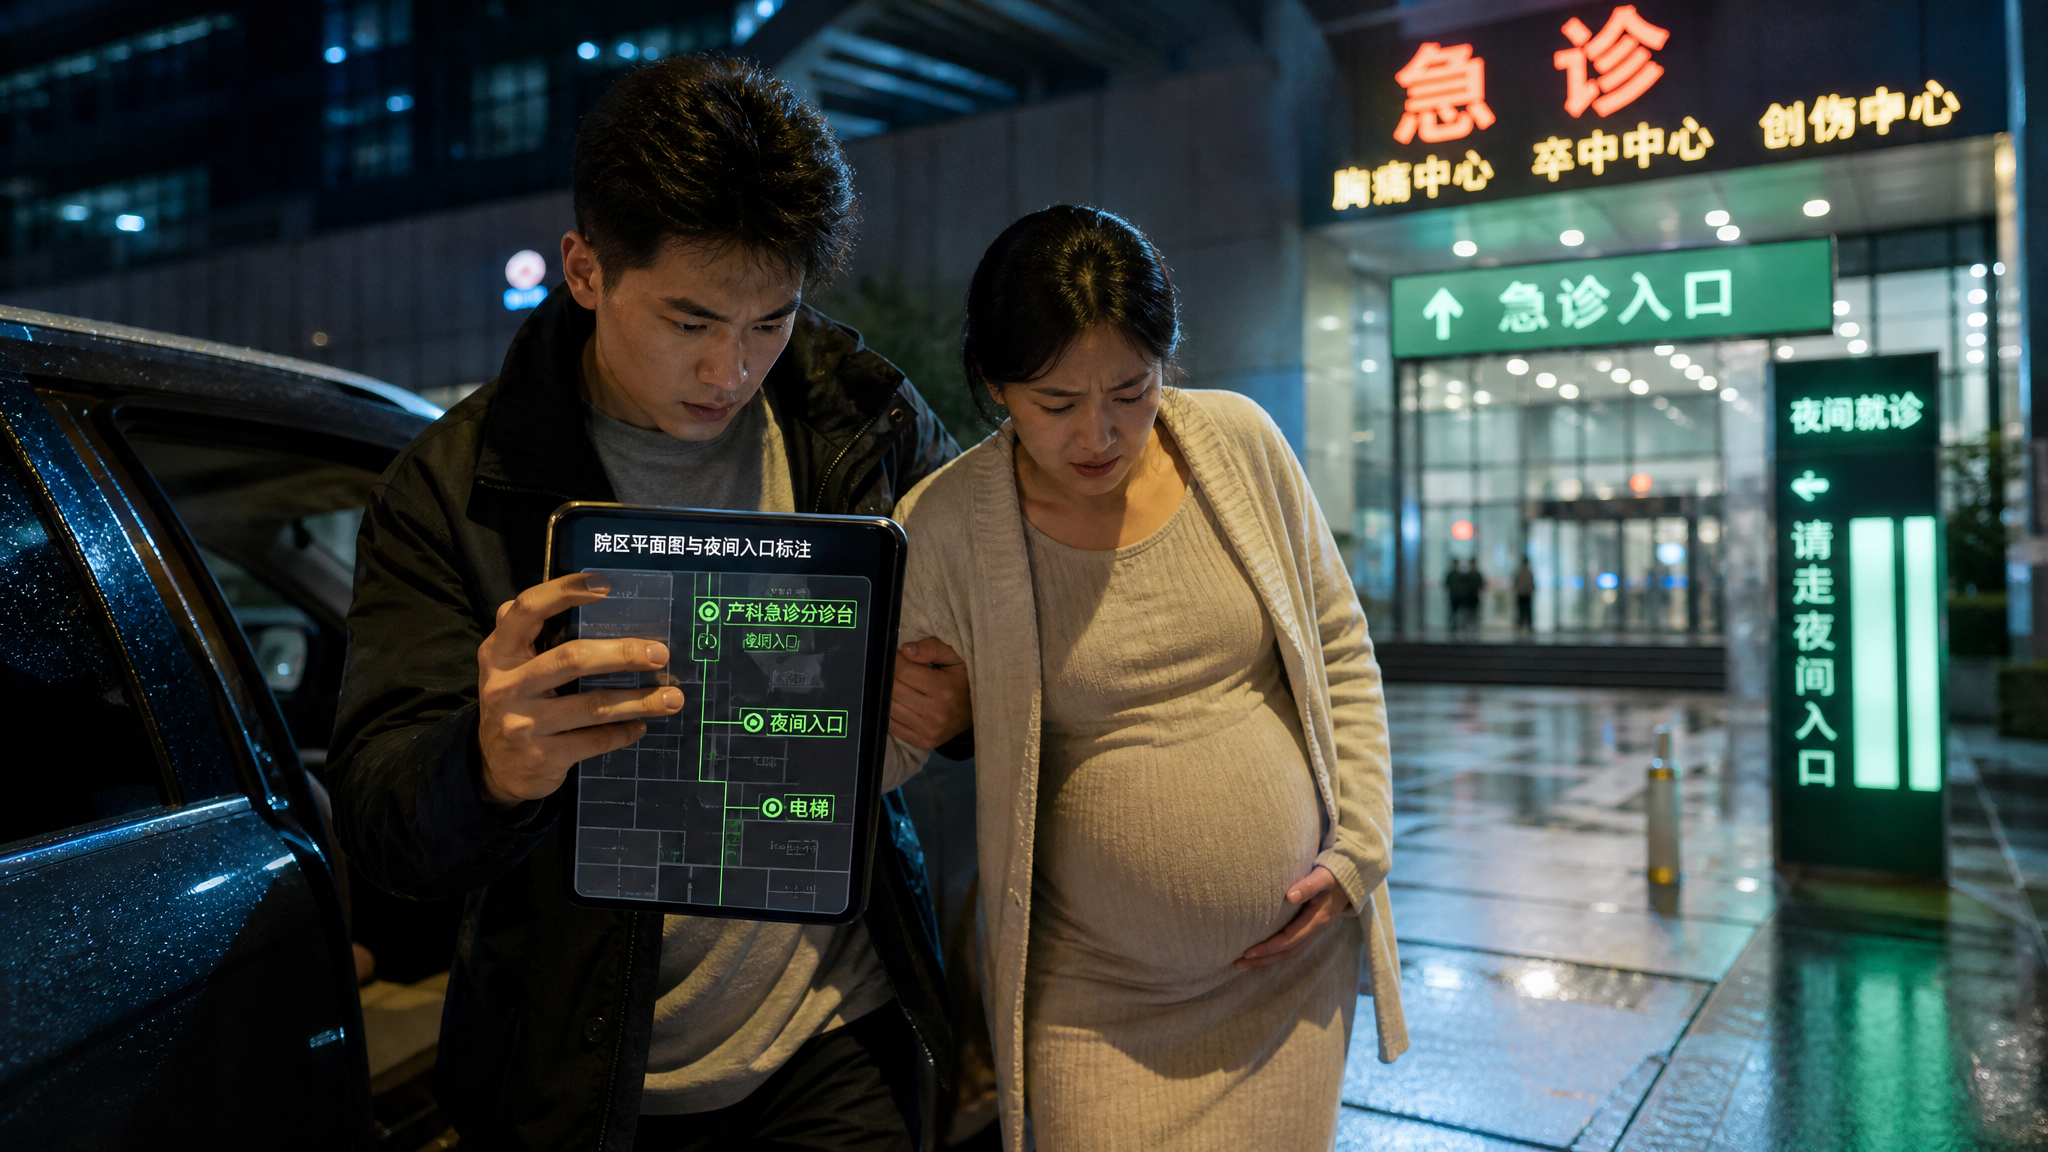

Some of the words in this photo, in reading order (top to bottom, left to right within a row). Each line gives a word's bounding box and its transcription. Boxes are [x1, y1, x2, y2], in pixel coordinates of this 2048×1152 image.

[1392, 4, 1671, 145] 急诊
[1758, 79, 1960, 149] 创伤中心
[1332, 149, 1495, 211] 胸痛中心
[1531, 115, 1715, 183] 卒中中心
[1498, 269, 1734, 335] 急诊入口
[1789, 390, 1925, 435] 夜间就诊
[594, 533, 812, 559] 院区平面图与夜间入口标注
[727, 601, 853, 624] 产科急诊分诊台
[1790, 518, 1838, 788] 请走夜间入口
[769, 713, 843, 734] 夜间入口
[789, 798, 829, 819] 电梯
